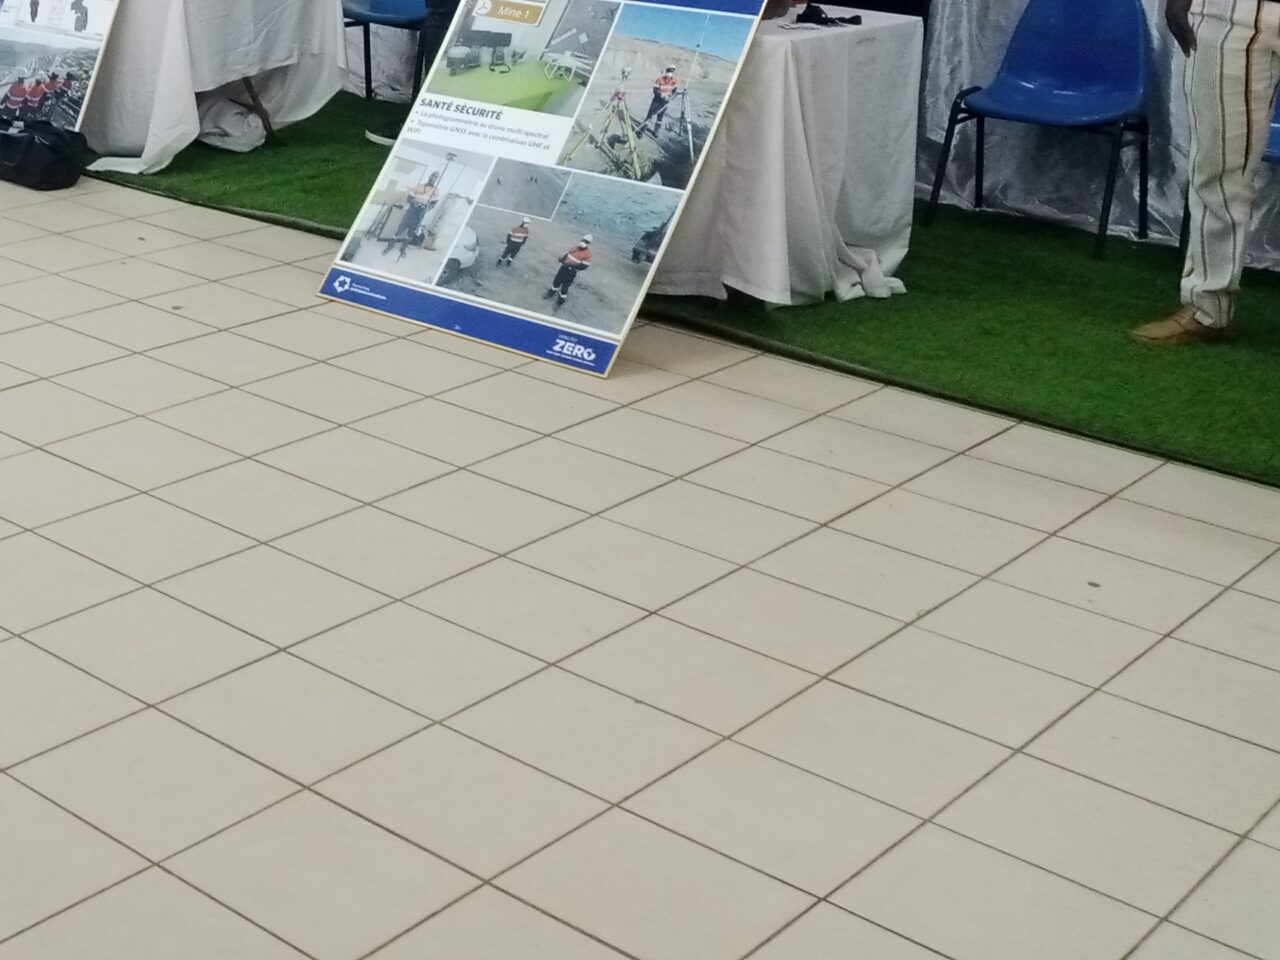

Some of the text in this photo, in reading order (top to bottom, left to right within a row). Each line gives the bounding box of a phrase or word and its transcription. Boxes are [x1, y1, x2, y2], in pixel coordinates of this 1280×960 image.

[497, 5, 530, 19] Mine 1
[420, 97, 504, 121] SANTÉ SÉCURITÉ
[428, 112, 479, 128] photogrammétrie
[487, 122, 506, 131] drone
[506, 125, 523, 134] multi
[523, 128, 550, 140] spectral
[449, 124, 467, 135] GNSS
[467, 129, 481, 138] avec
[488, 133, 528, 146] combinaison
[527, 140, 543, 149] UHF
[552, 338, 597, 361] ZERO
